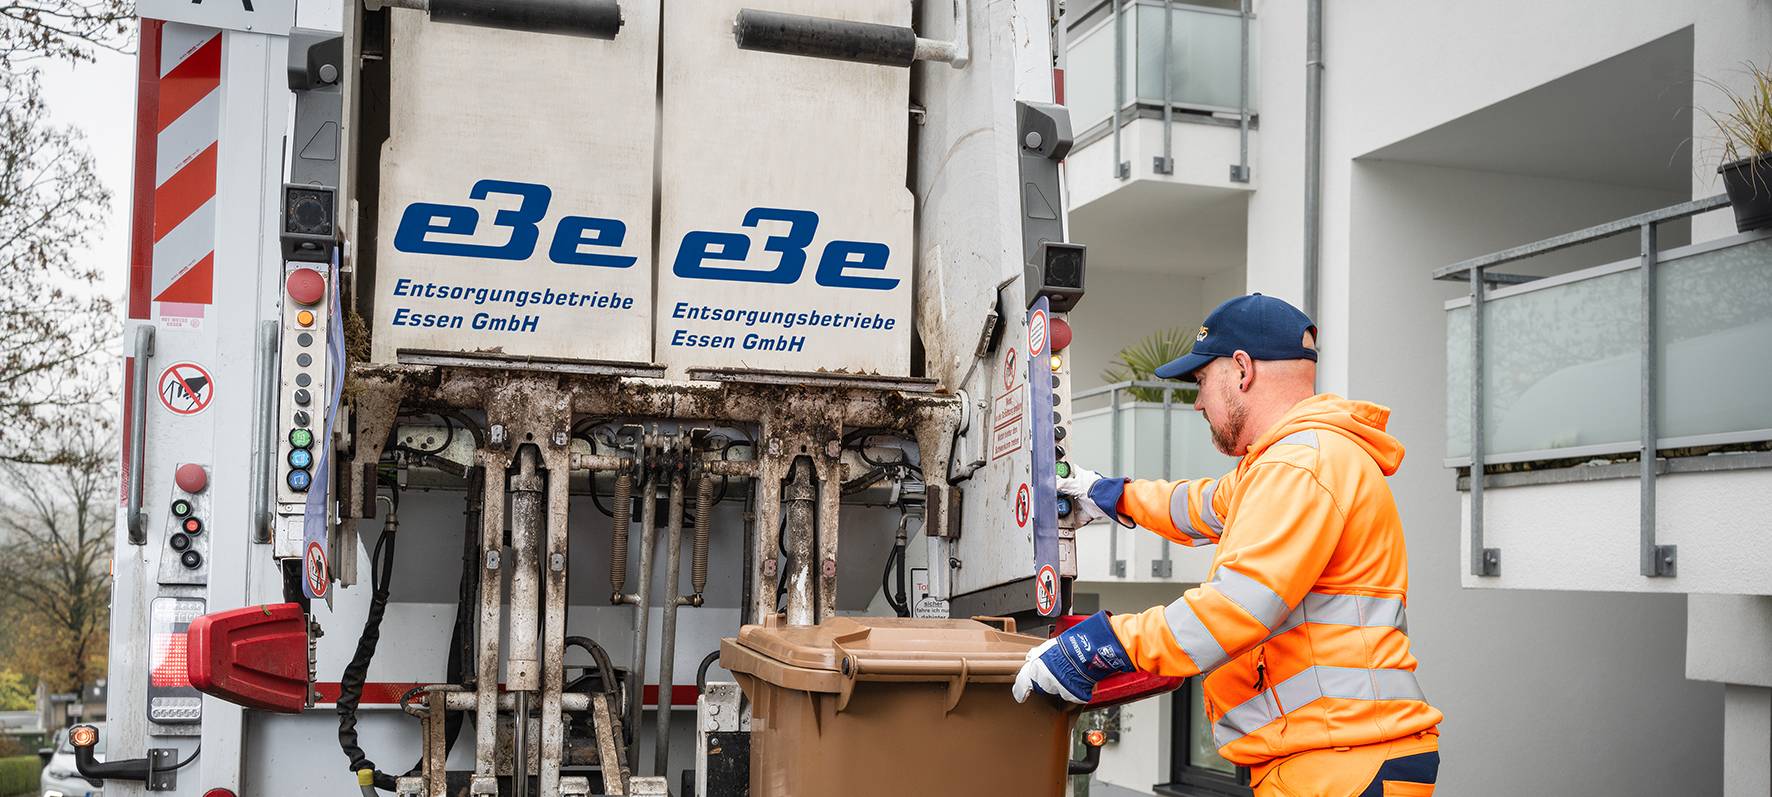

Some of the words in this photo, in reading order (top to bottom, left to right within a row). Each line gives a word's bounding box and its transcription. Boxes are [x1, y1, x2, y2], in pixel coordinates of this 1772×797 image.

[394, 179, 638, 268] e3e
[673, 207, 900, 290] e3e
[393, 278, 634, 310] Entsorgungsbetriebe
[392, 308, 464, 329] Essen
[471, 312, 539, 333] GmbH
[672, 302, 896, 330] Entsorgungsbetriebe
[671, 329, 735, 349] Essen
[742, 333, 806, 352] GmbH
[917, 583, 929, 591] To
